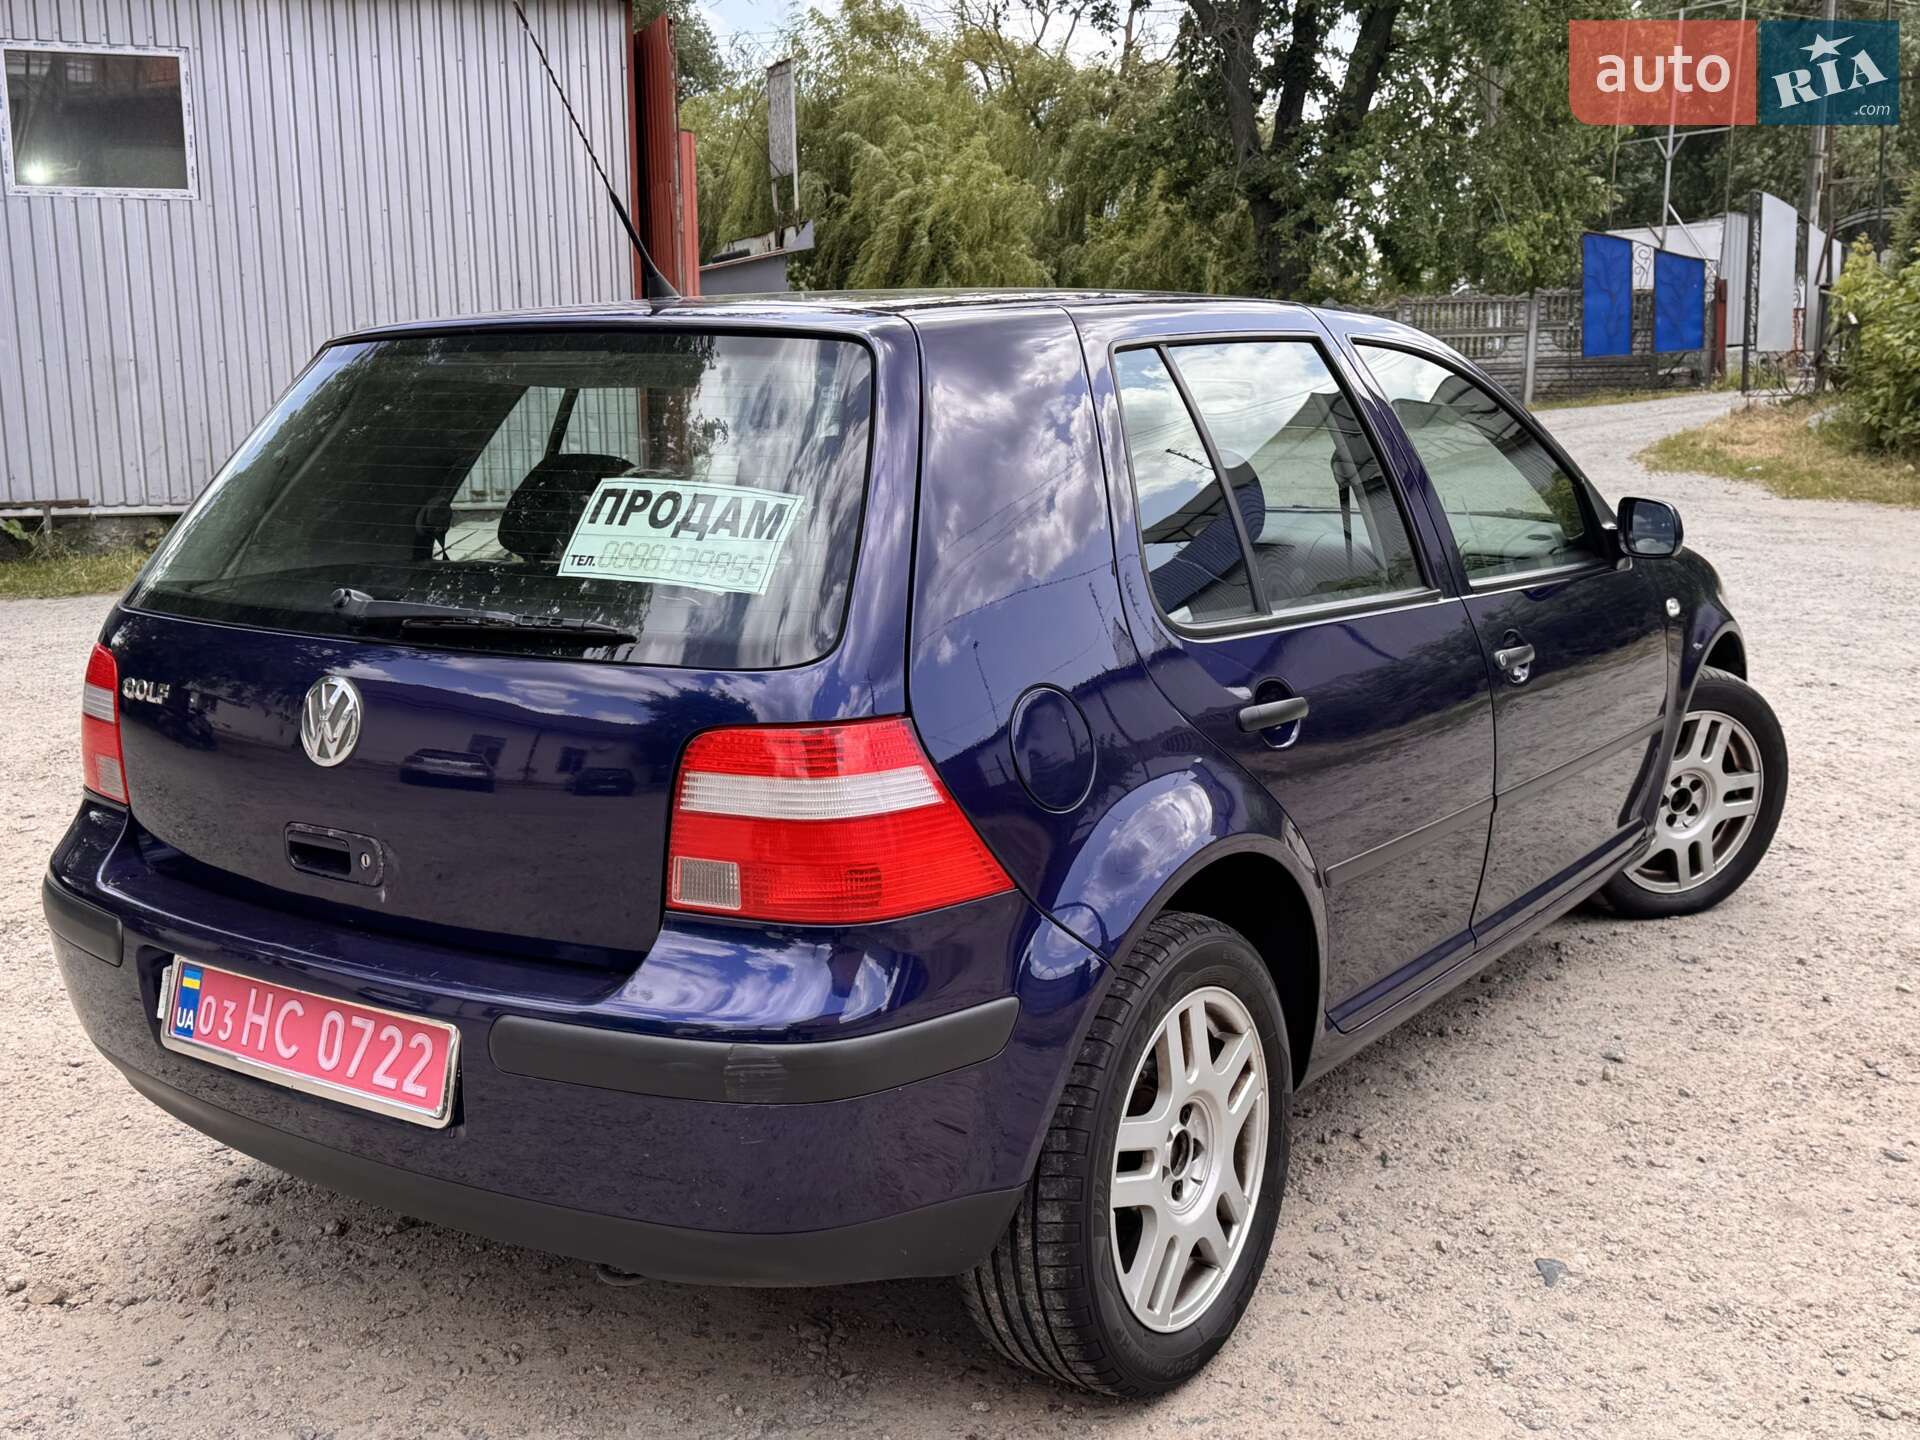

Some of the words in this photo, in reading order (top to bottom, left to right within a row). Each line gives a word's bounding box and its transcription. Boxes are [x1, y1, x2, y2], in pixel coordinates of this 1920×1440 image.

[587, 488, 790, 541] ПРОДАМ
[570, 554, 596, 568] ТЕЛ.
[122, 676, 171, 705] GOLF
[176, 1007, 194, 1031] UA
[199, 995, 237, 1041] 03
[241, 988, 304, 1059] HC
[317, 1010, 433, 1098] 0722
